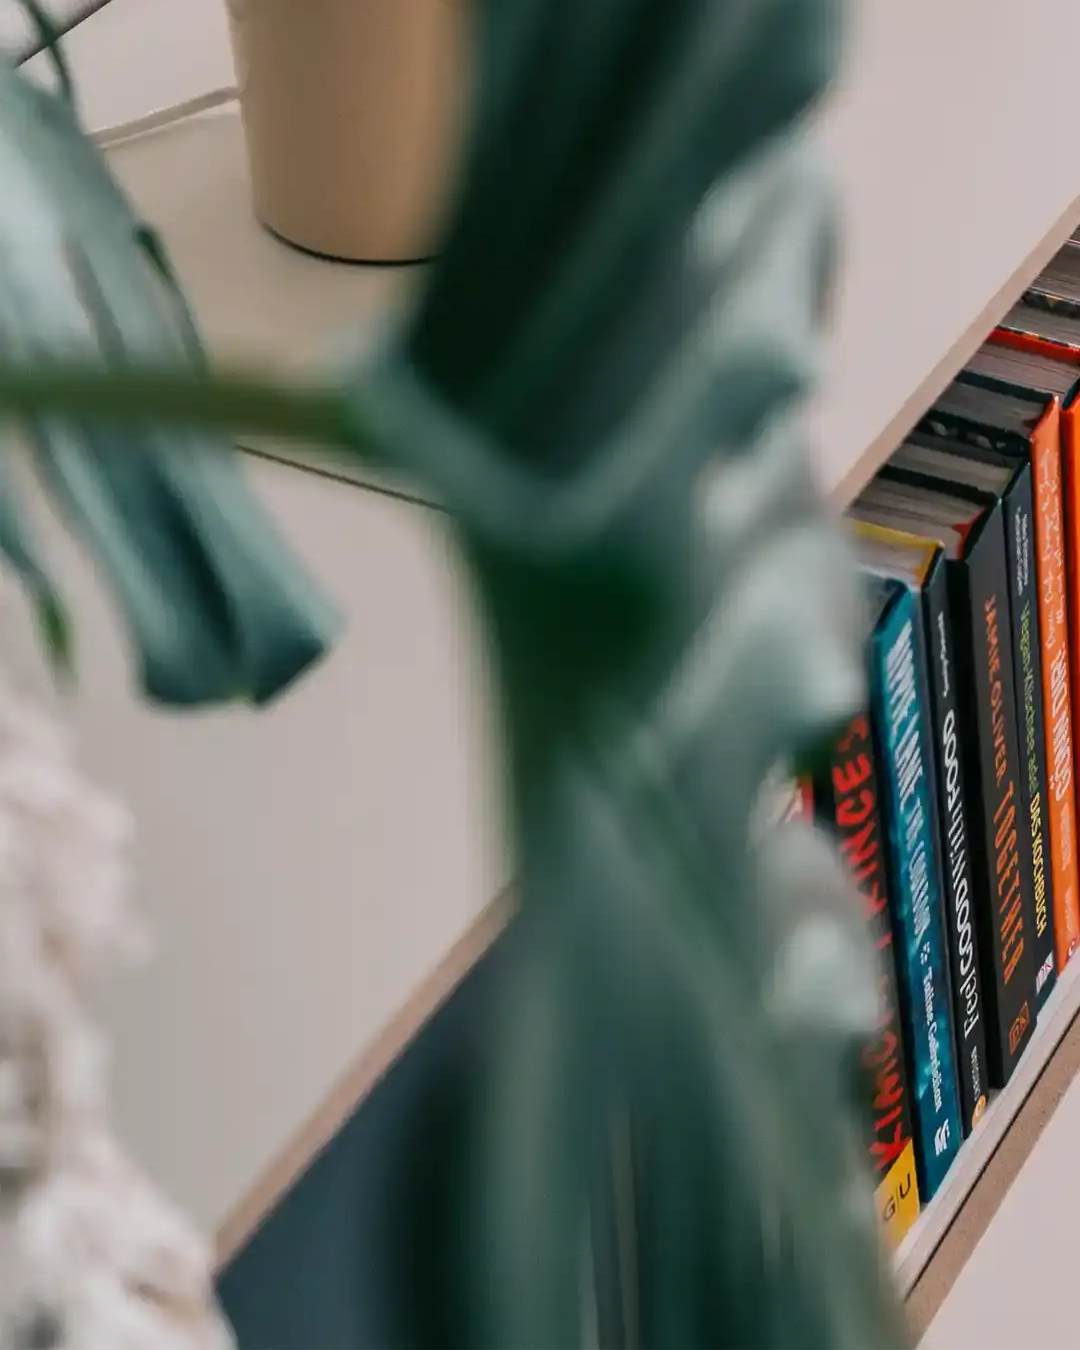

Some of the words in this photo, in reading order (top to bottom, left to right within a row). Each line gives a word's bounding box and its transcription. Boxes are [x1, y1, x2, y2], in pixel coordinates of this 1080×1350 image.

[885, 617, 917, 738] HIPPIE
[984, 593, 1000, 684] JAMIE
[894, 712, 924, 812] LANE
[943, 708, 960, 813] FOOD
[990, 679, 1007, 789] OLIVER
[1049, 709, 1072, 802] GÖNN
[1029, 791, 1042, 838] DAS
[909, 840, 932, 949] COOKBOOK
[993, 779, 1024, 985] TOGETHER
[1032, 832, 1048, 938] KOCHBUCH
[922, 964, 934, 1027] Taline
[1009, 1001, 1030, 1053] DK
[926, 1021, 943, 1114] Gabrielian
